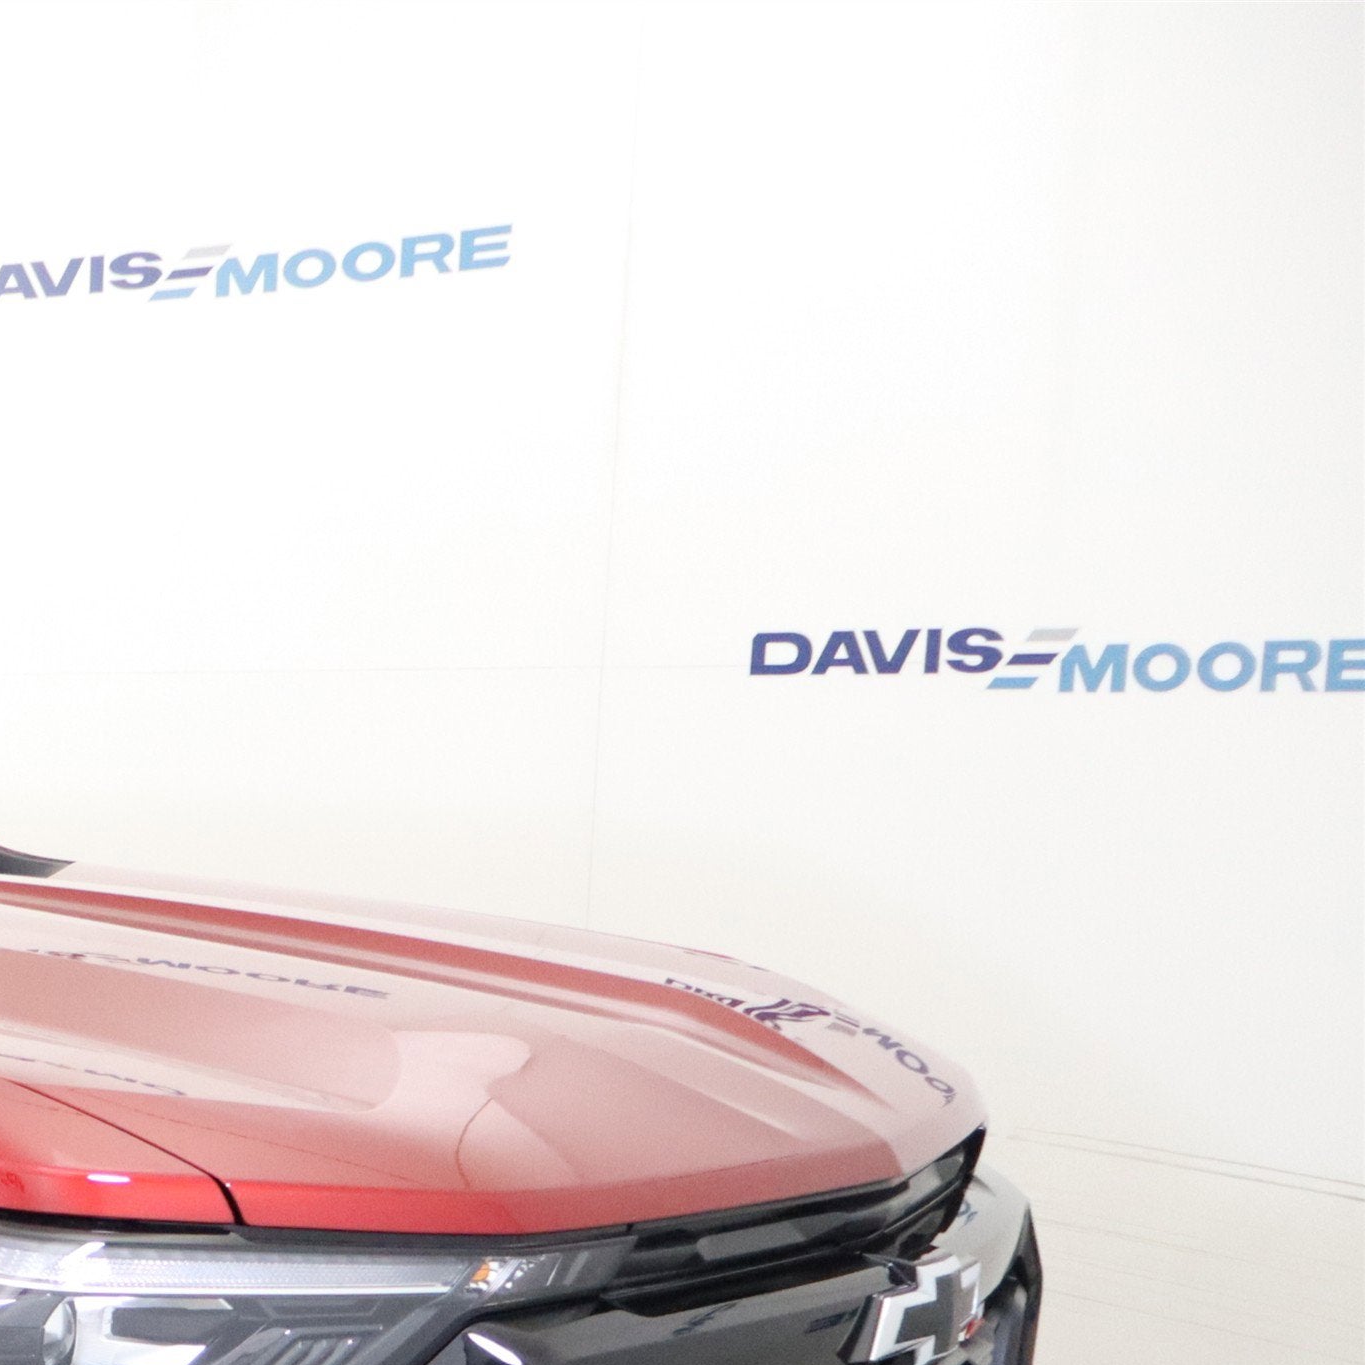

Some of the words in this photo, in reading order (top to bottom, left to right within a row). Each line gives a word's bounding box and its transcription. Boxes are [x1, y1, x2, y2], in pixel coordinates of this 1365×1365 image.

[214, 223, 514, 298] MOORE
[748, 627, 1007, 676] DAVIS
[1057, 637, 1365, 694] MOORE
